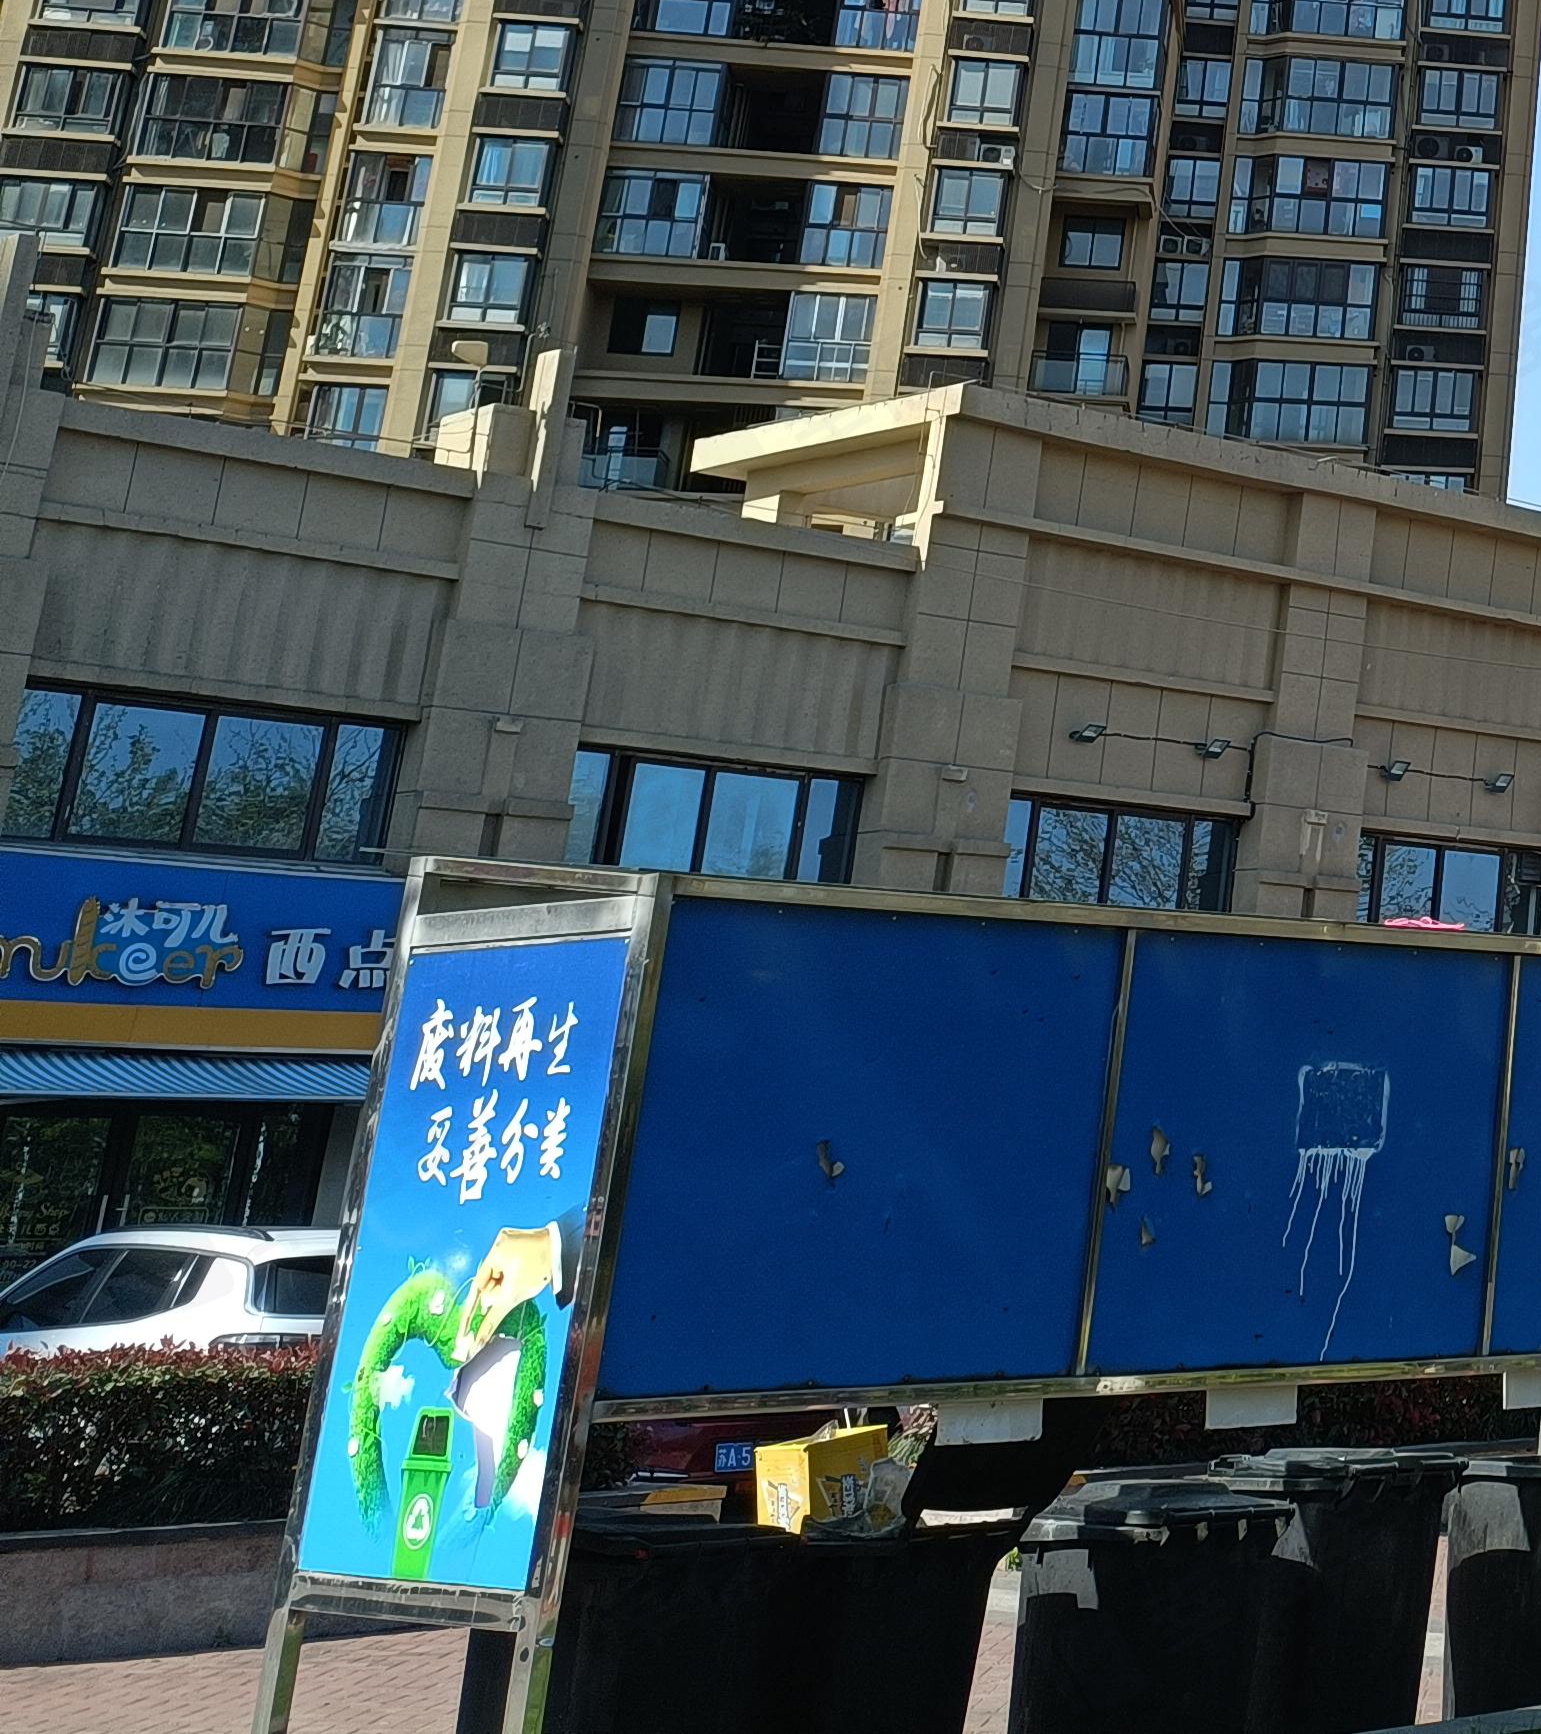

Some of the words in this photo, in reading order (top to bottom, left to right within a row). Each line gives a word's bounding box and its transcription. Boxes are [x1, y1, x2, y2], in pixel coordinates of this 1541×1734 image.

[265, 928, 395, 989] 西点
[409, 996, 580, 1092] 废料再生
[416, 1089, 573, 1205] 妥善分类
